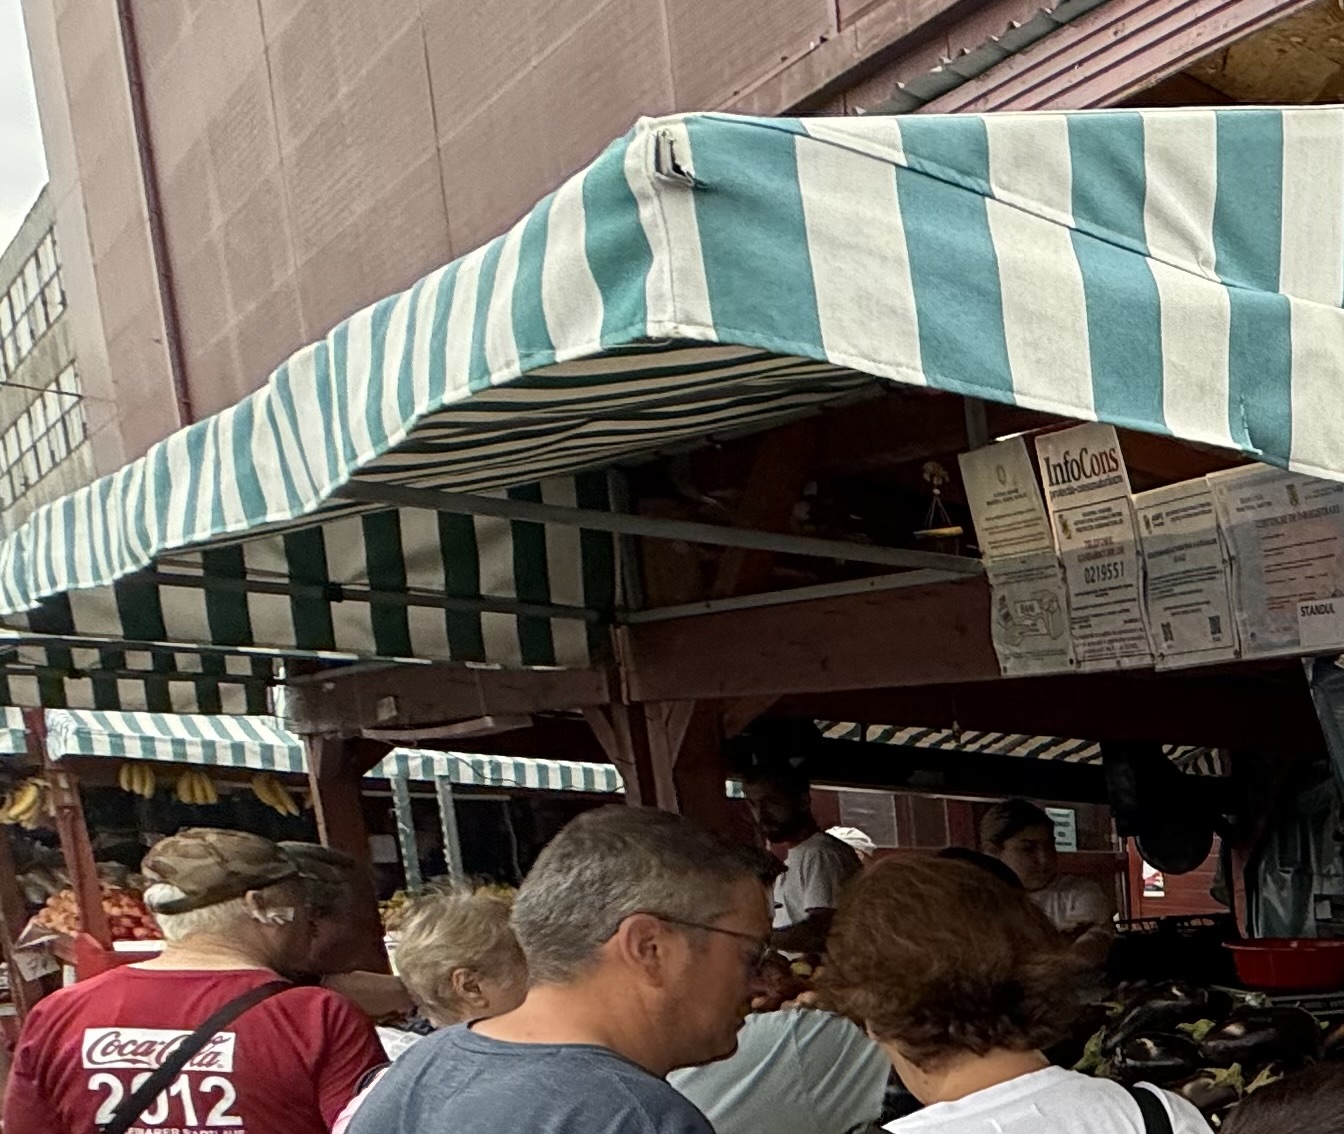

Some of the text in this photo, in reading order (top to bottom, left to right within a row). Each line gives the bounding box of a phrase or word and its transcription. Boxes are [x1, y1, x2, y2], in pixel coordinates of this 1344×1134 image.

[1044, 447, 1119, 487] InfoCons
[1084, 561, 1124, 584] 0219551
[1301, 603, 1335, 617] STANDUL
[86, 1030, 230, 1069] Coca-Cla
